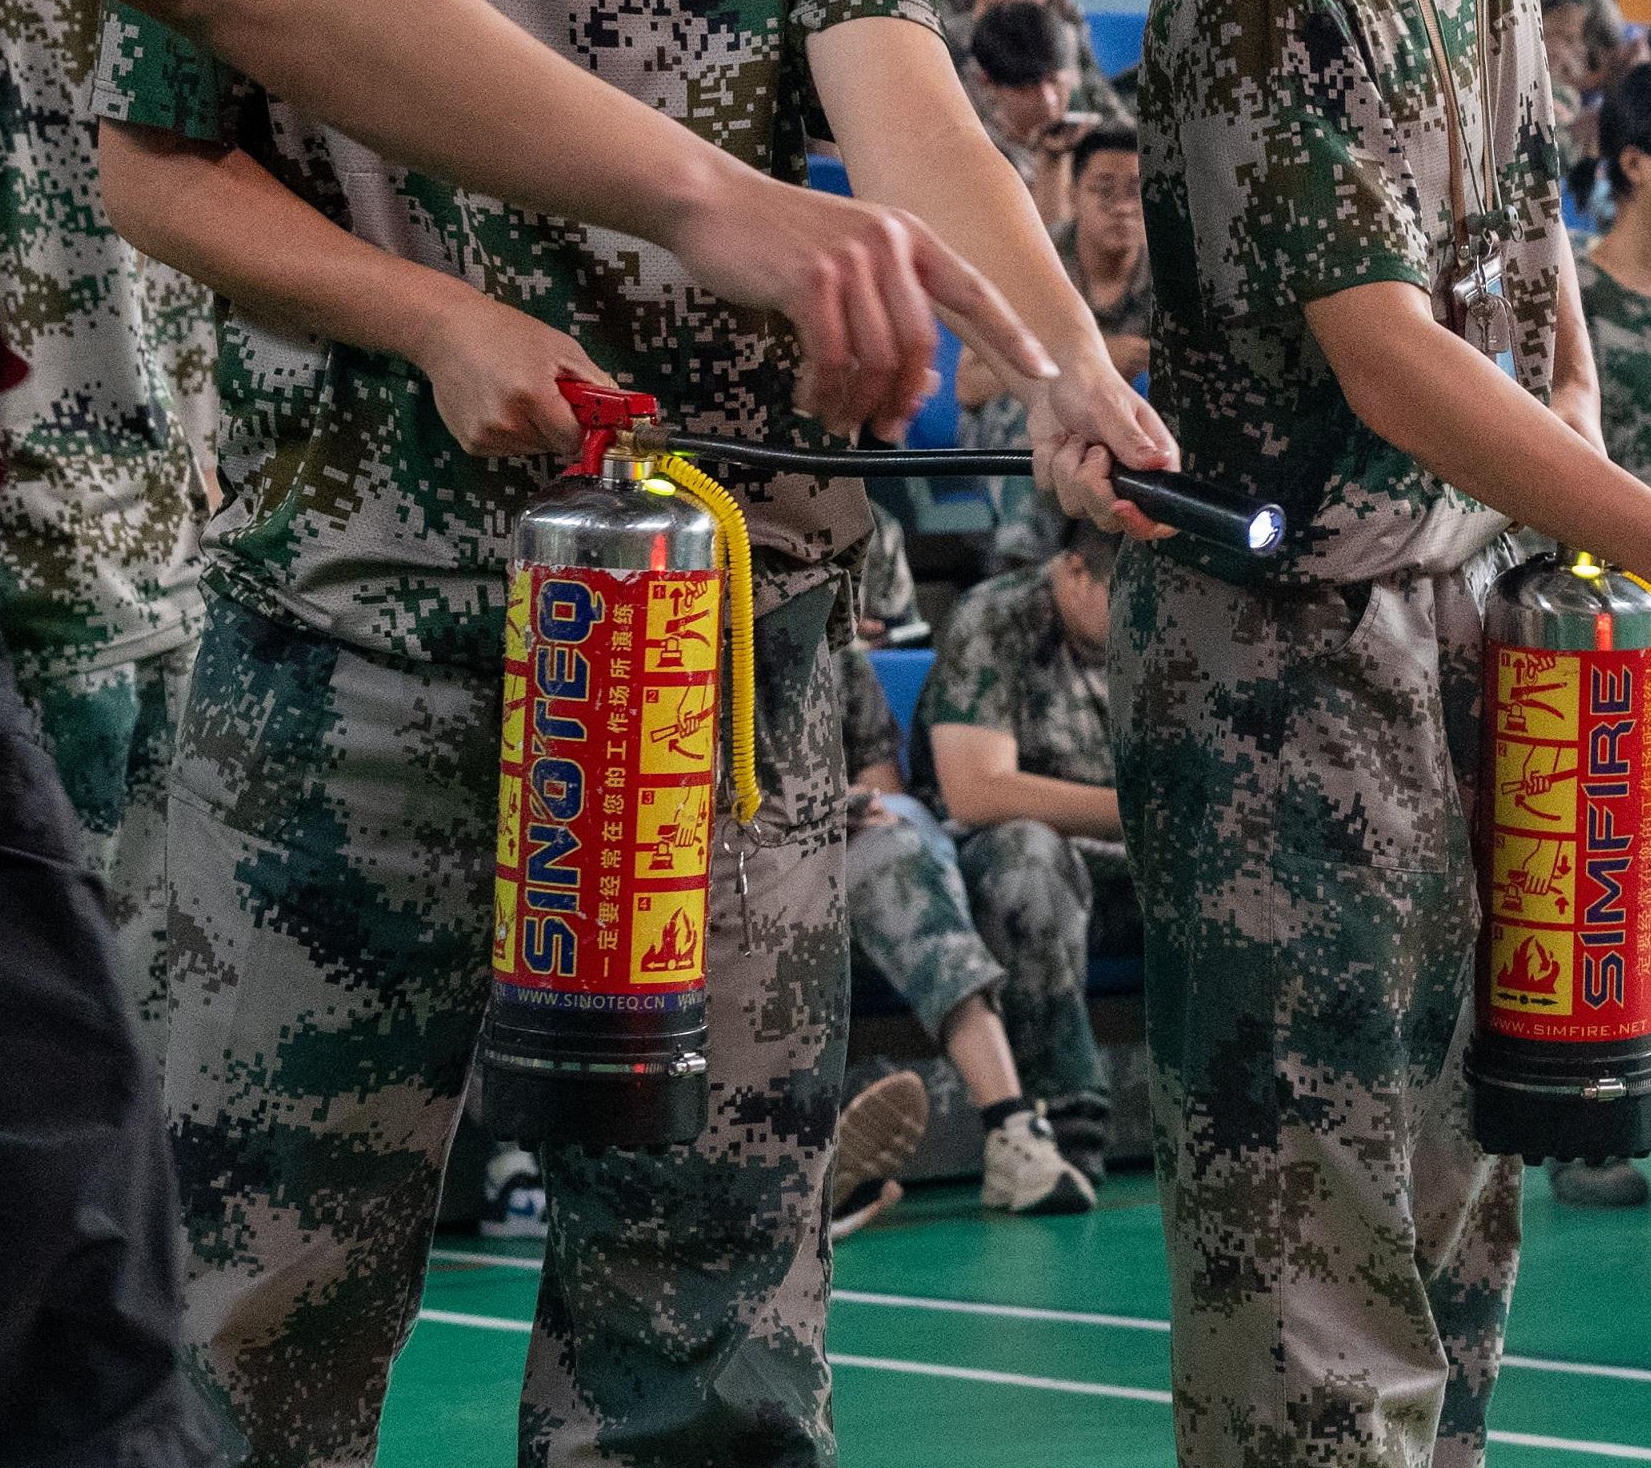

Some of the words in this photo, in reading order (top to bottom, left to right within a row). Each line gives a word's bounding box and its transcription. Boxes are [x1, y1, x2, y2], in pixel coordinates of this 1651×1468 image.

[521, 579, 606, 978] SINOTEQ
[597, 602, 635, 978] 一定要经常在您的工作场所演练
[1580, 663, 1635, 1009] SIMFIRE
[516, 988, 665, 1012] WWW.SINOTEQ.CN
